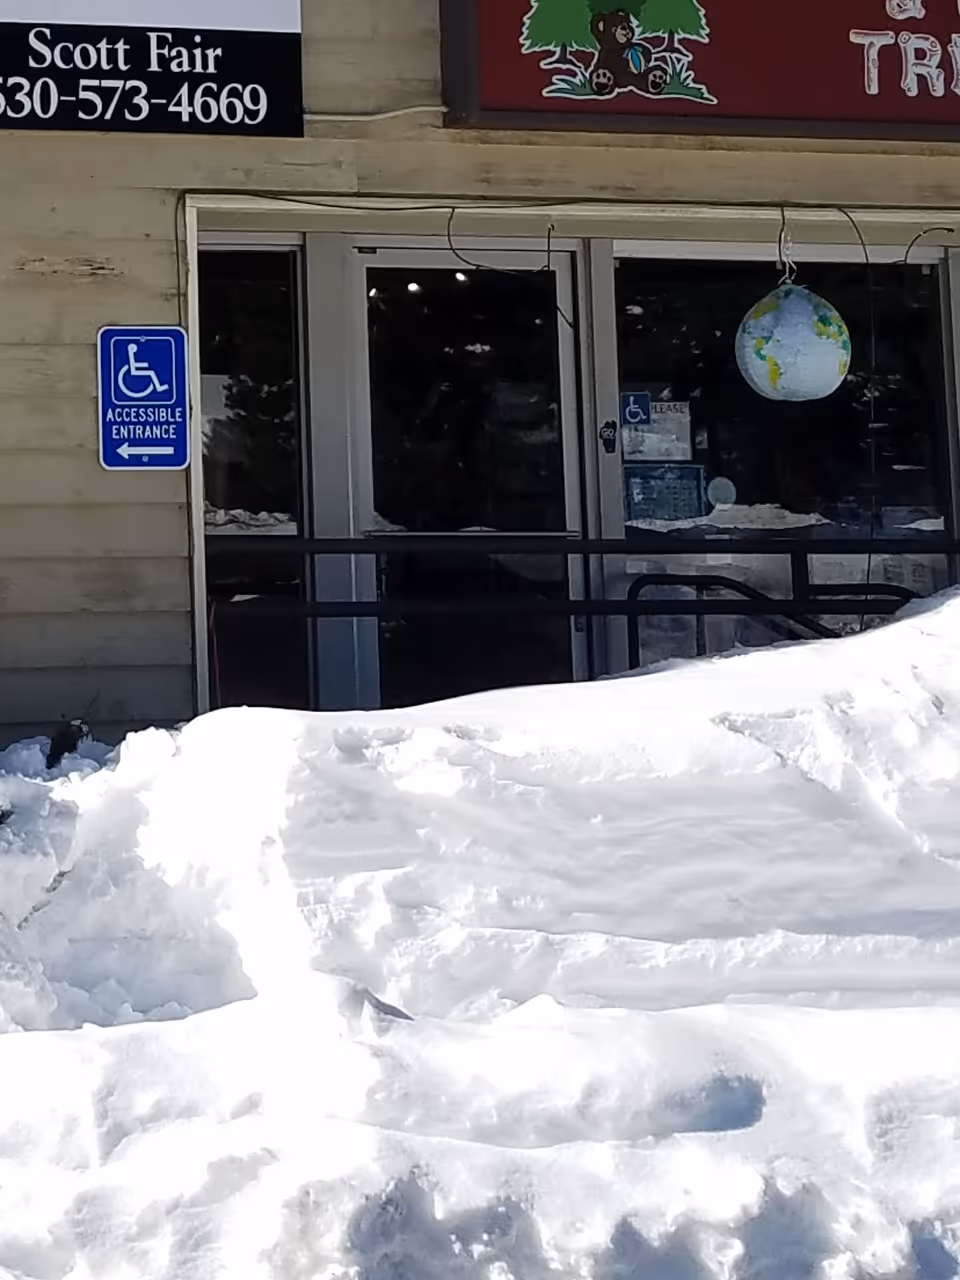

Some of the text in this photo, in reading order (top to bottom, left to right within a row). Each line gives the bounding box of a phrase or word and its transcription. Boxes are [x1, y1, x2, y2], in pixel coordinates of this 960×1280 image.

[28, 27, 222, 74] Scott Fair
[849, 29, 960, 97] TR
[106, 407, 183, 422] ACCESSIBLE
[112, 424, 177, 439] ENTRANCE
